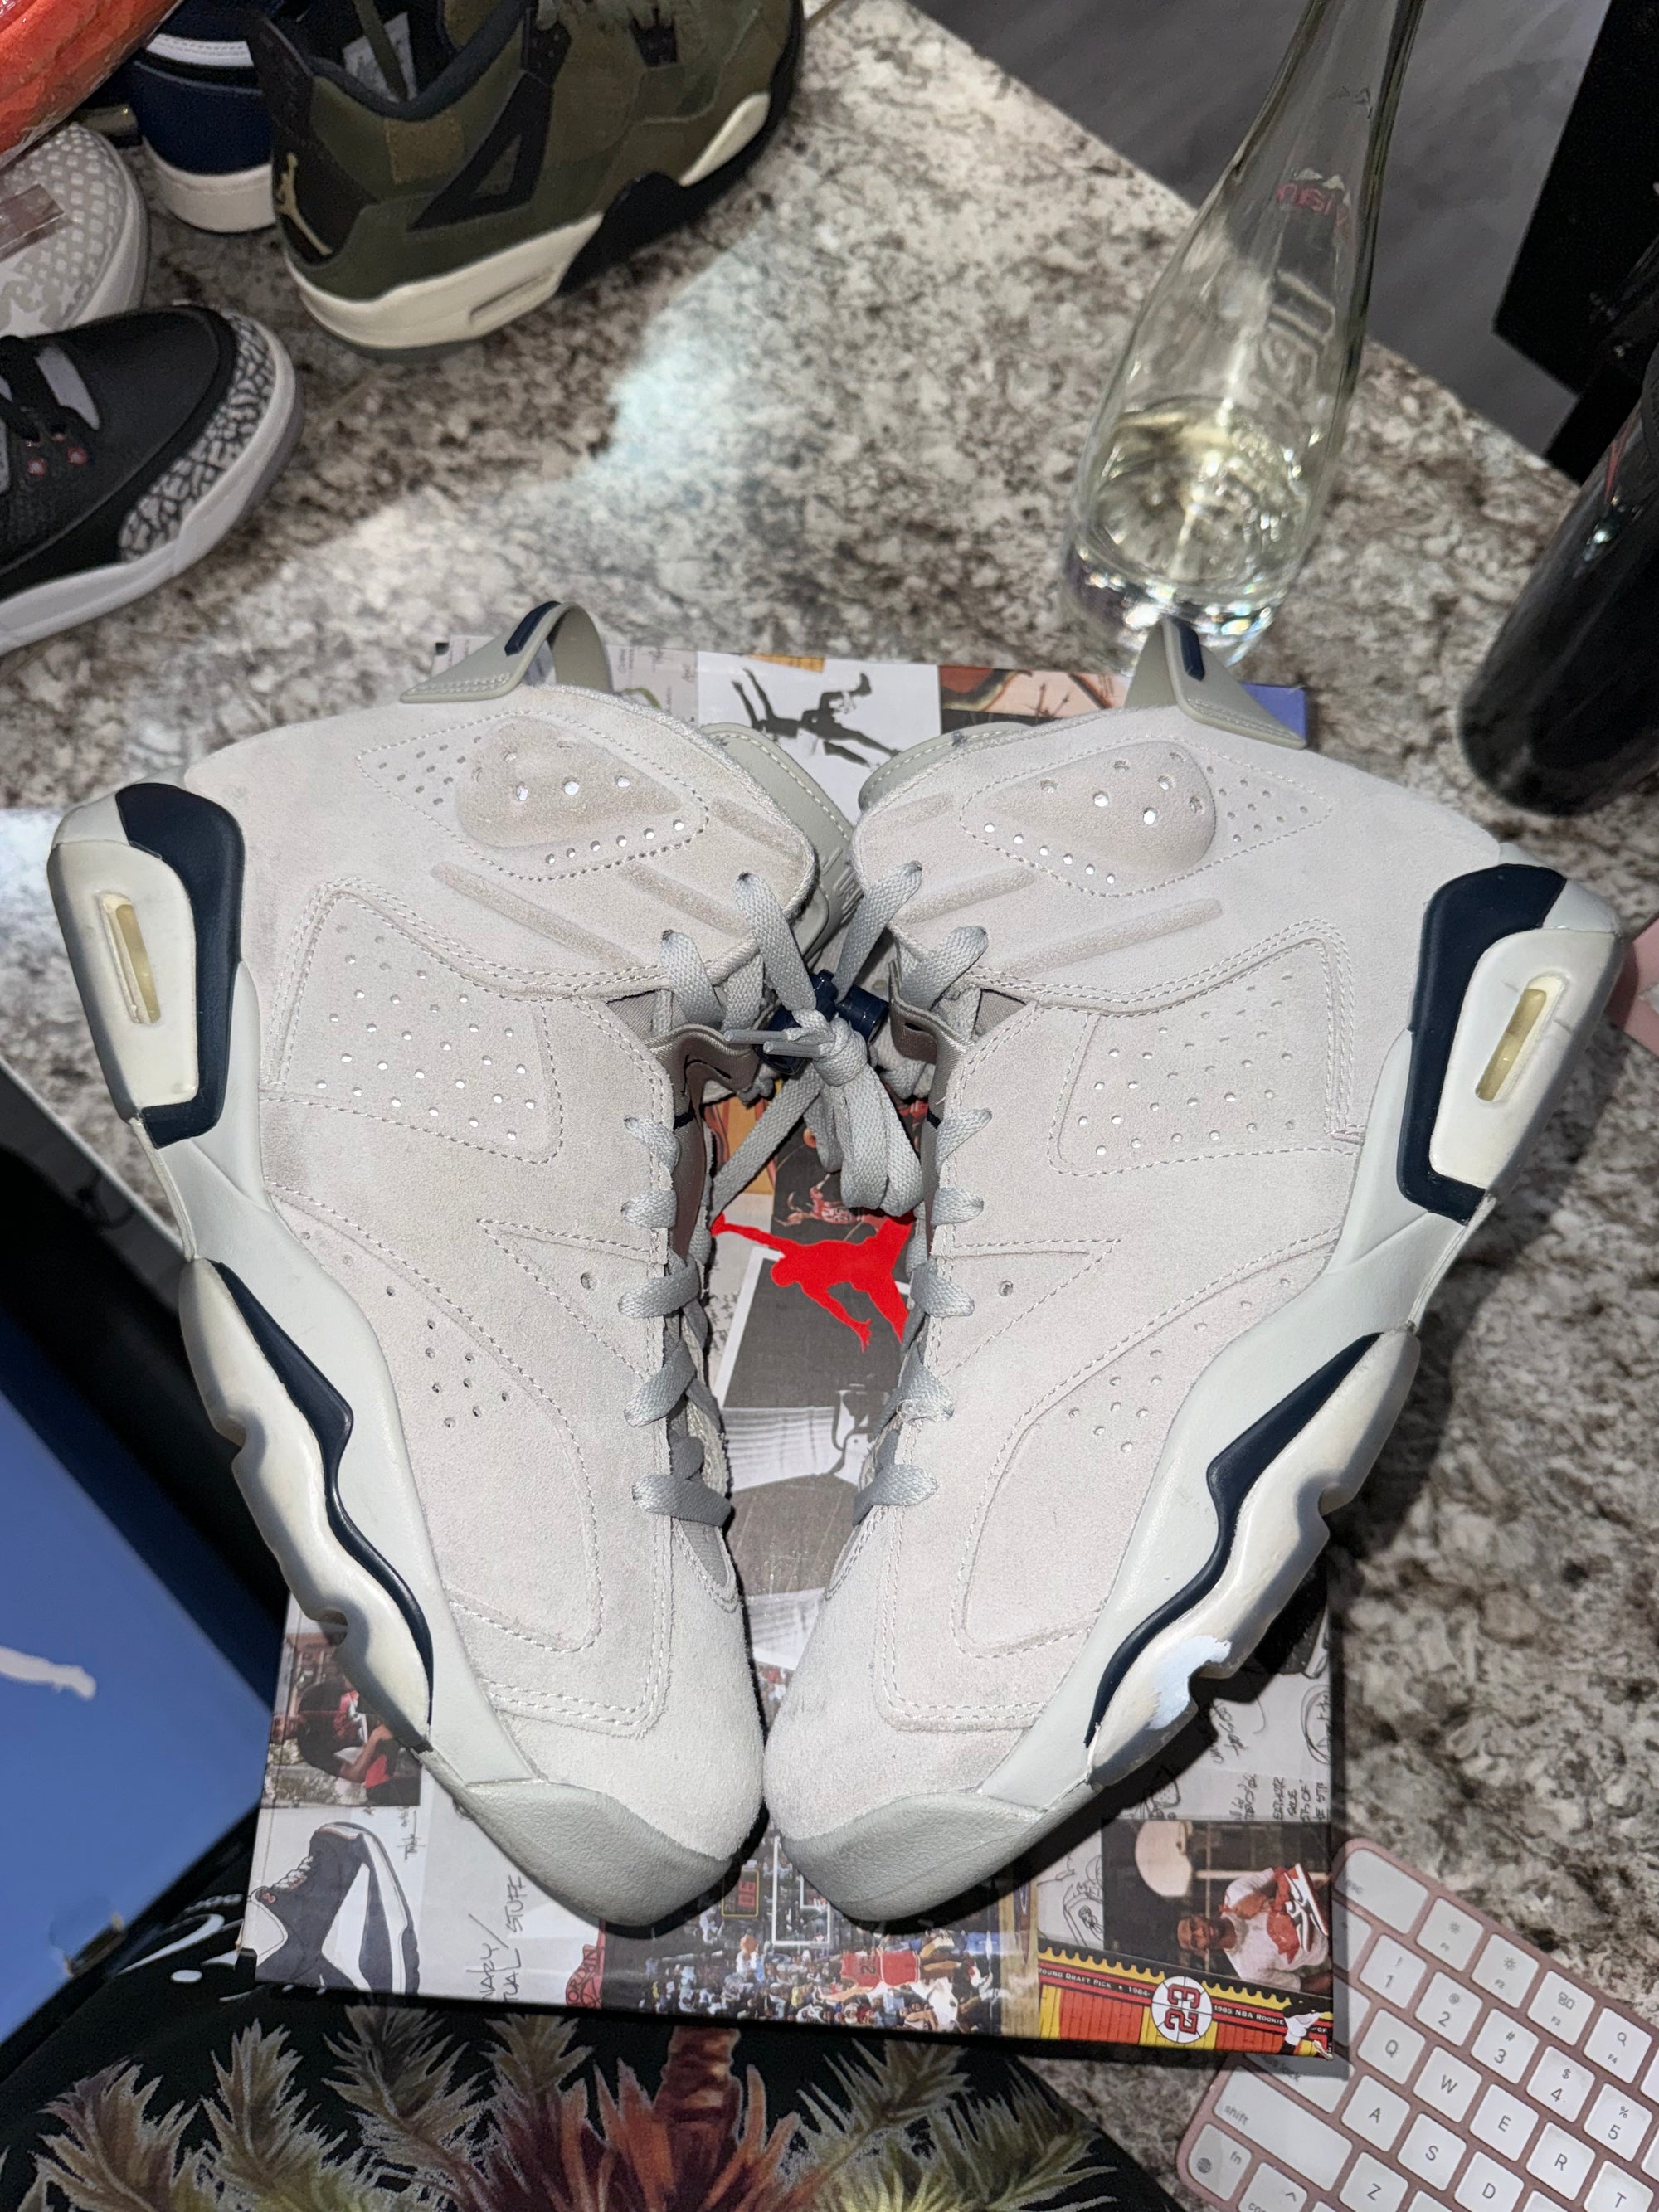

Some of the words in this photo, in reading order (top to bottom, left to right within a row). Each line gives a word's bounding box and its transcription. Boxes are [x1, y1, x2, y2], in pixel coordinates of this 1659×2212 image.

[504, 1874, 528, 1933] STUFF
[567, 1949, 599, 2005] ORDAN
[1065, 1972, 1091, 1984] DRAFT
[1093, 1979, 1112, 1989] PICK
[1385, 1974, 1394, 1988] 1
[1494, 1979, 1506, 1989] F2
[1165, 1983, 1201, 2035] 23
[1214, 2005, 1233, 2015] 1985
[1235, 2009, 1253, 2019] NBA
[1256, 2014, 1285, 2025] ROOKIE
[1438, 2011, 1451, 2027] 2
[1551, 2016, 1561, 2026] F3
[1384, 2039, 1399, 2058] Q
[1494, 2049, 1506, 2064] 3
[1608, 2054, 1618, 2064] F4
[1441, 2075, 1458, 2093] W
[1550, 2088, 1563, 2102] 4
[1224, 2104, 1249, 2125] shift
[1368, 2107, 1381, 2123] A
[1497, 2115, 1511, 2132] E
[1608, 2124, 1621, 2140] 5
[1230, 2151, 1243, 2165] fn
[1425, 2145, 1439, 2161] S
[1554, 2153, 1568, 2171] R
[1366, 2183, 1382, 2201] Z
[1481, 2183, 1496, 2199] D
[1614, 2192, 1627, 2209] T
